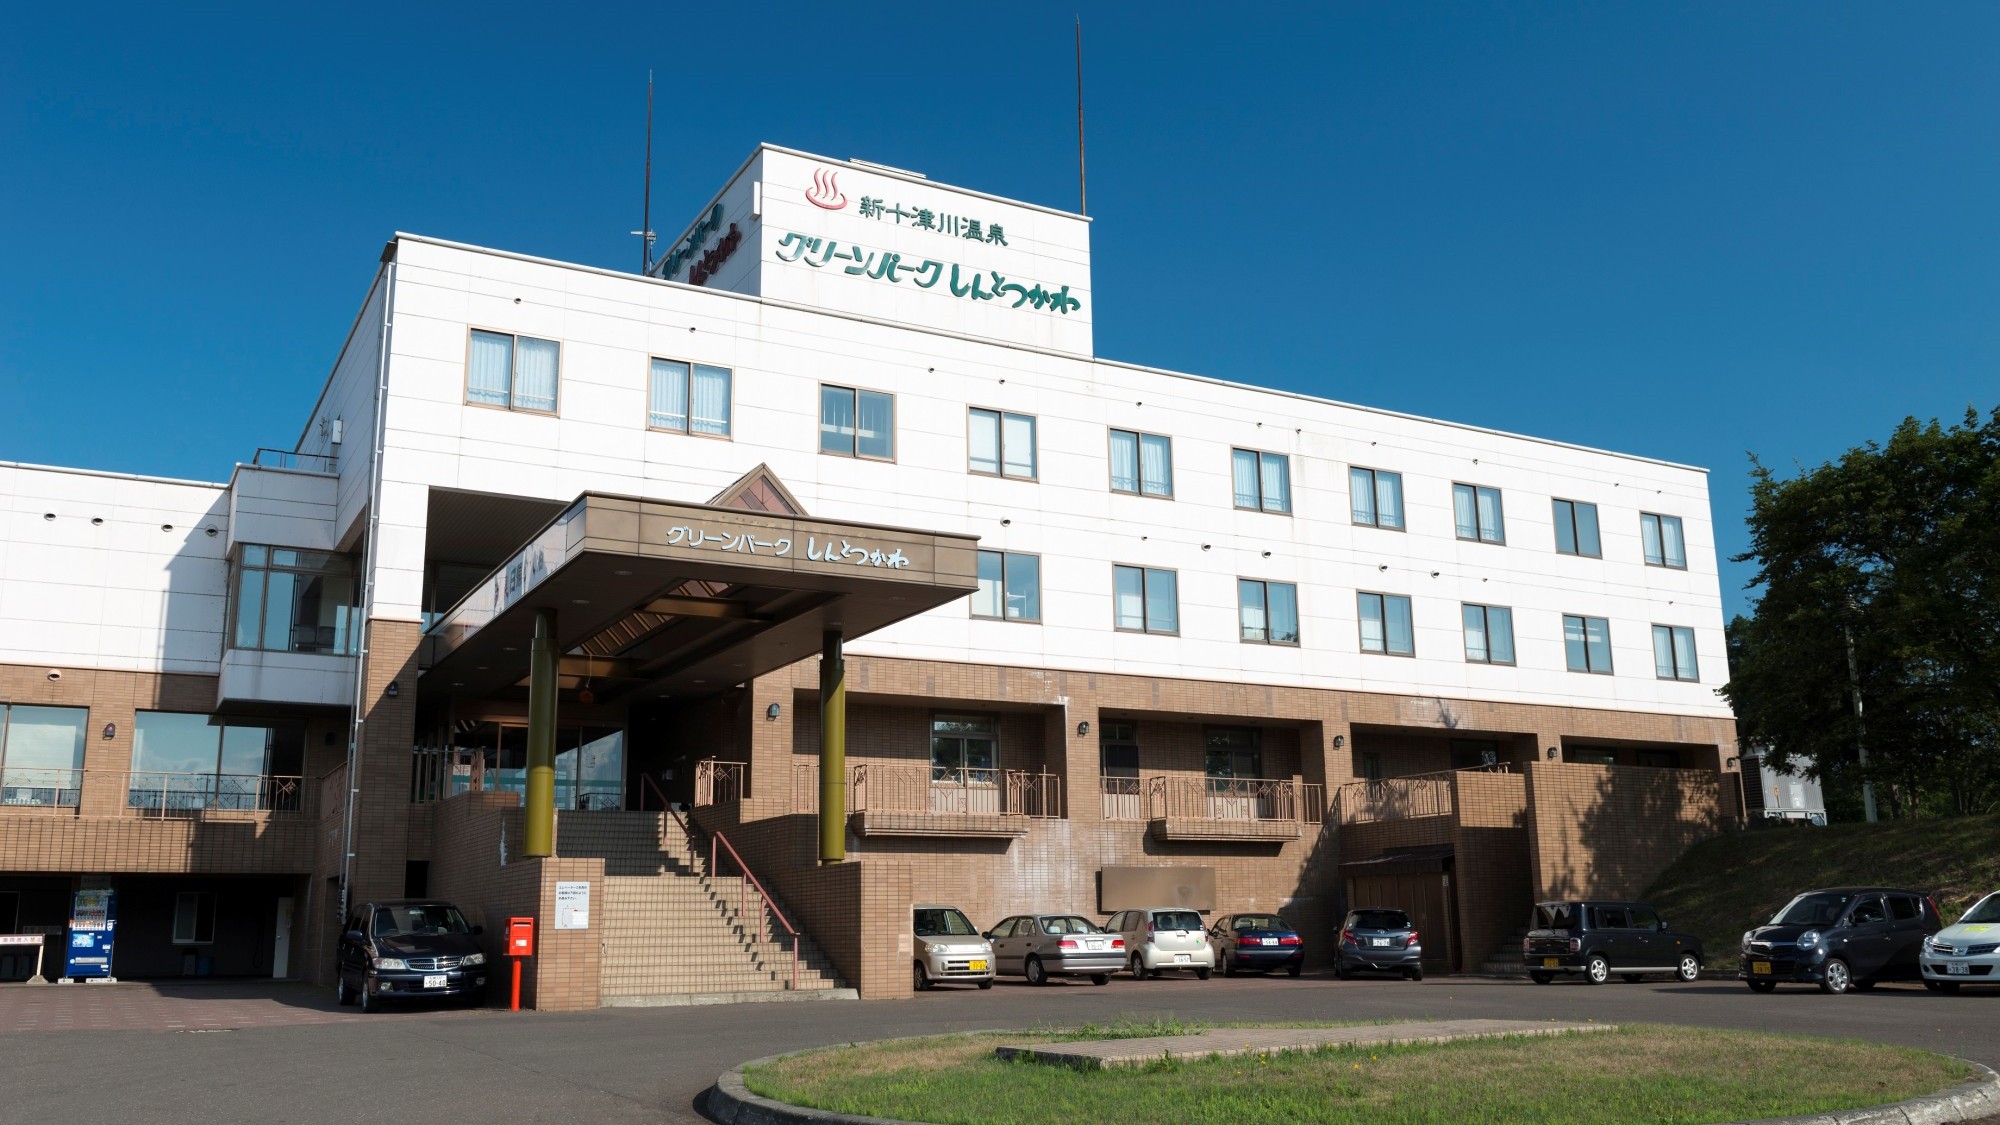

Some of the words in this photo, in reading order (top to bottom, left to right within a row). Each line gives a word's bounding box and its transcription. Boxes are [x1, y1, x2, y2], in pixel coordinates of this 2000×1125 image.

[859, 195, 1008, 247] 新十津川温泉
[776, 232, 944, 288] グリーンパーク
[950, 263, 1081, 314] しんとつかわ
[667, 526, 791, 556] グリーンパーク
[807, 536, 909, 569] しんとつかわ
